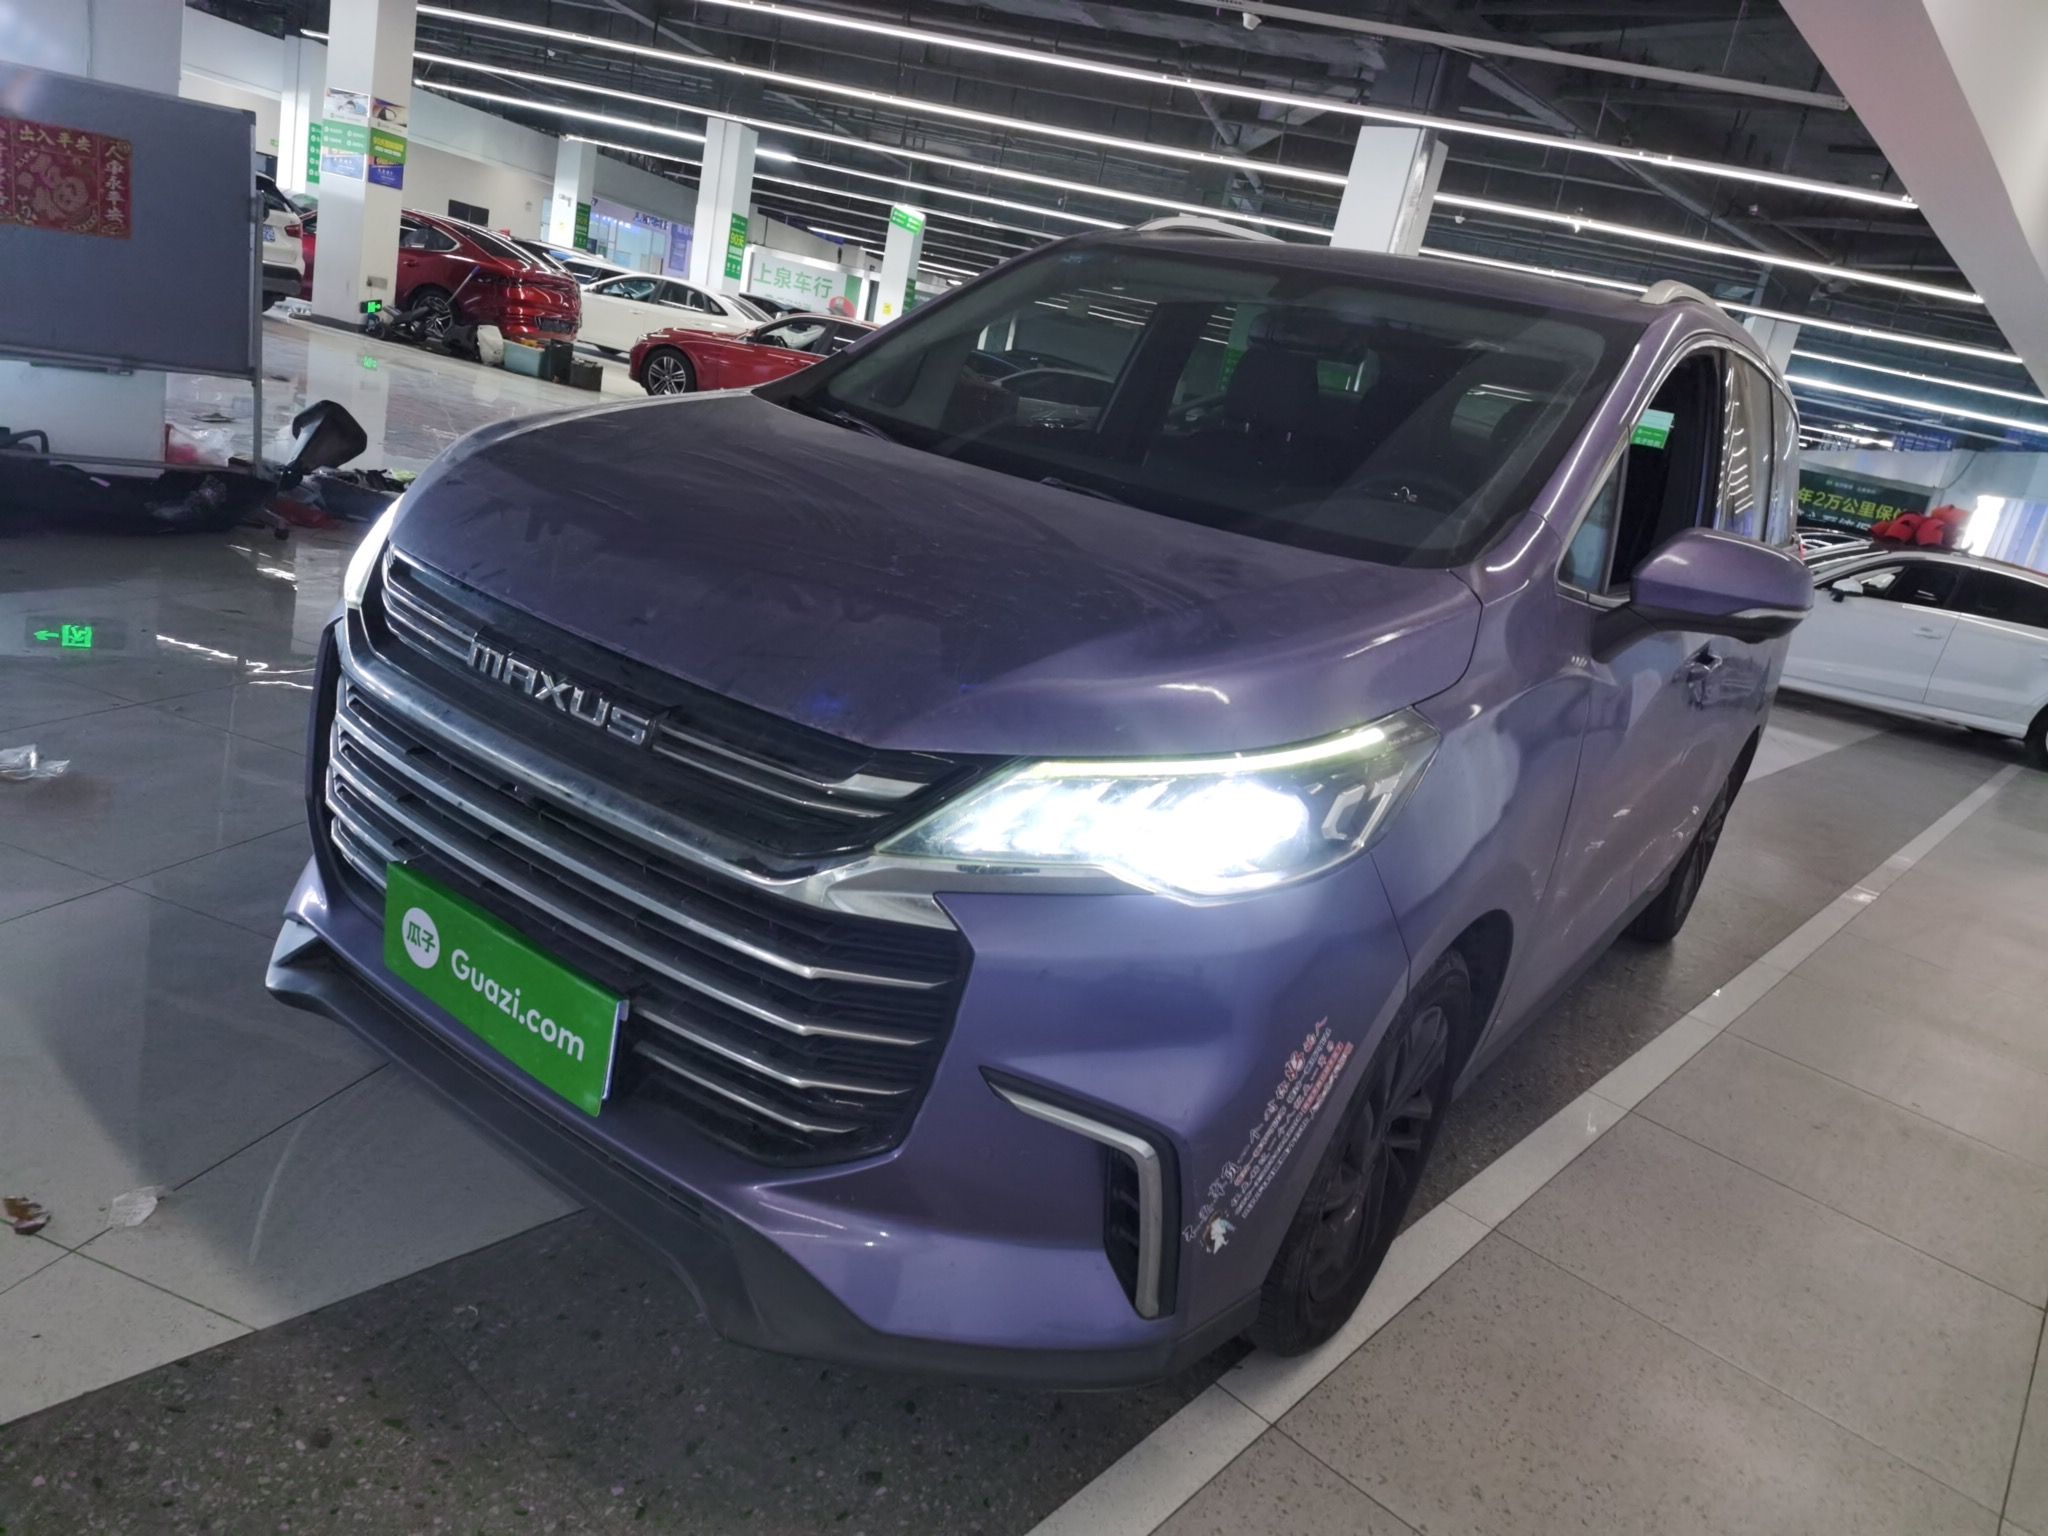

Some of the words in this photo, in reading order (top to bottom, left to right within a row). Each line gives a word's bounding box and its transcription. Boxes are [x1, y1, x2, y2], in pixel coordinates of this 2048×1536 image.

[754, 262, 833, 299] 上泉车行
[468, 640, 653, 745] MAXUS
[406, 919, 437, 955] 瓜子
[451, 948, 585, 1062] Guazi.com
